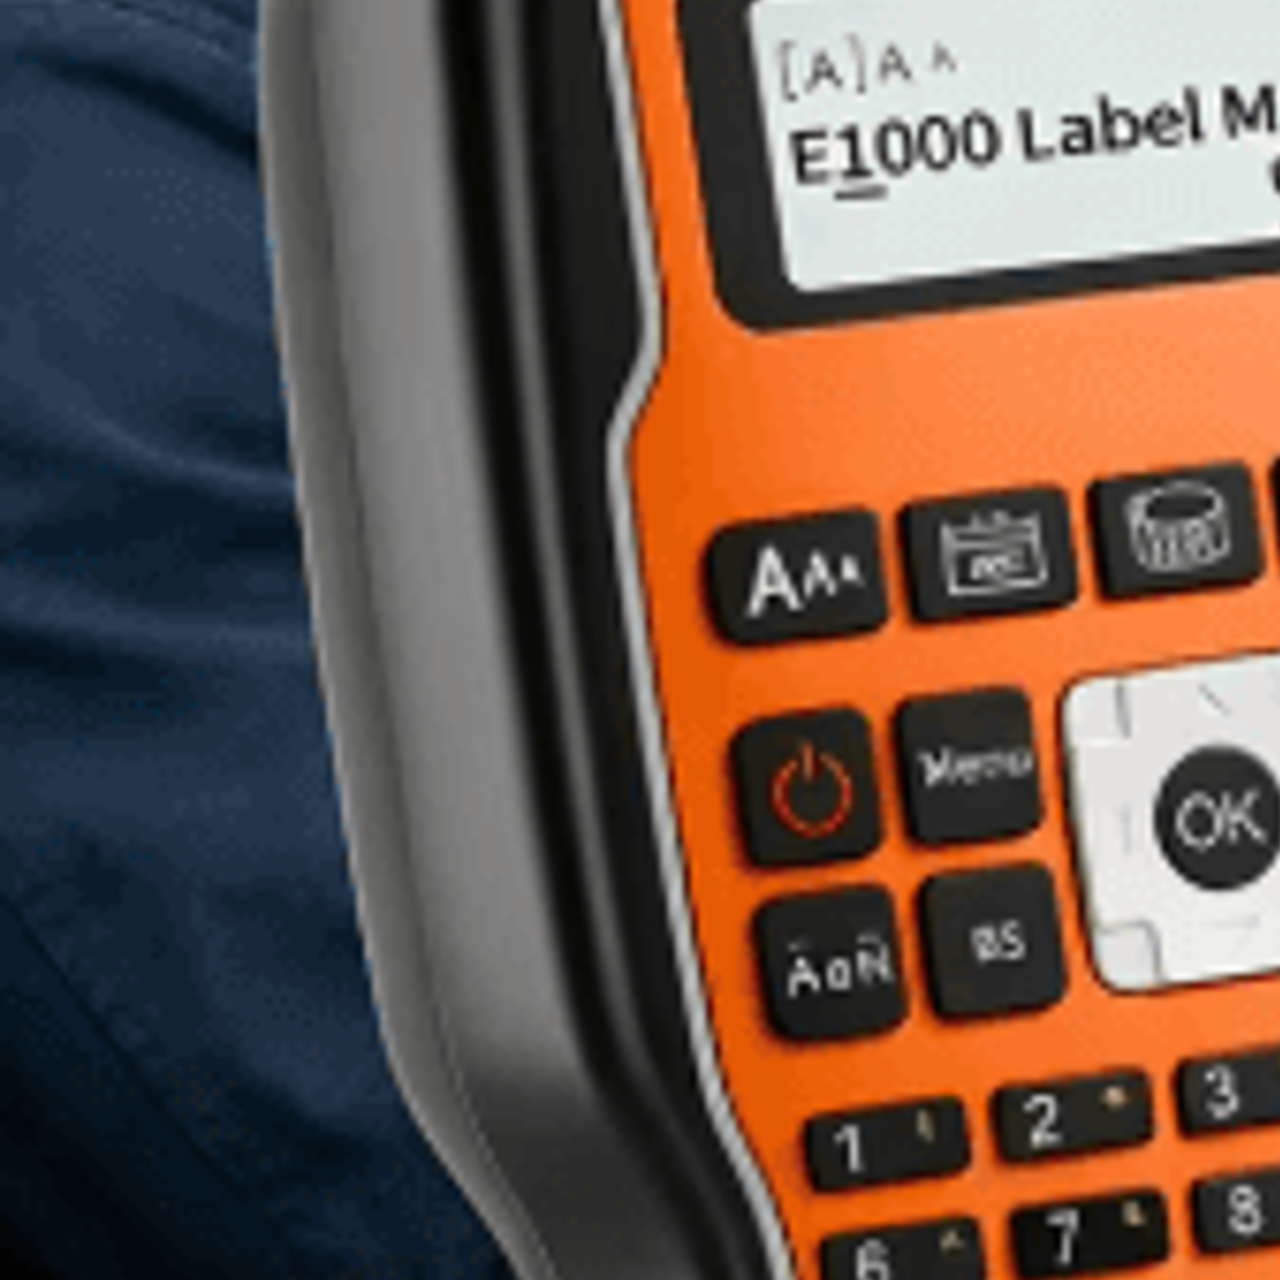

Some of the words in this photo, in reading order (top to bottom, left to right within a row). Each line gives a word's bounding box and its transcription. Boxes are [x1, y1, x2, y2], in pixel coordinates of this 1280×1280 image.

[791, 111, 1002, 192] E1000
[1018, 90, 1204, 162] Label
[1174, 789, 1267, 851] OK
[833, 1123, 862, 1174] 1
[1022, 1092, 1061, 1149] 2
[1203, 1065, 1241, 1121] 3
[1045, 1207, 1081, 1267] 7
[1227, 1183, 1264, 1236] 8
